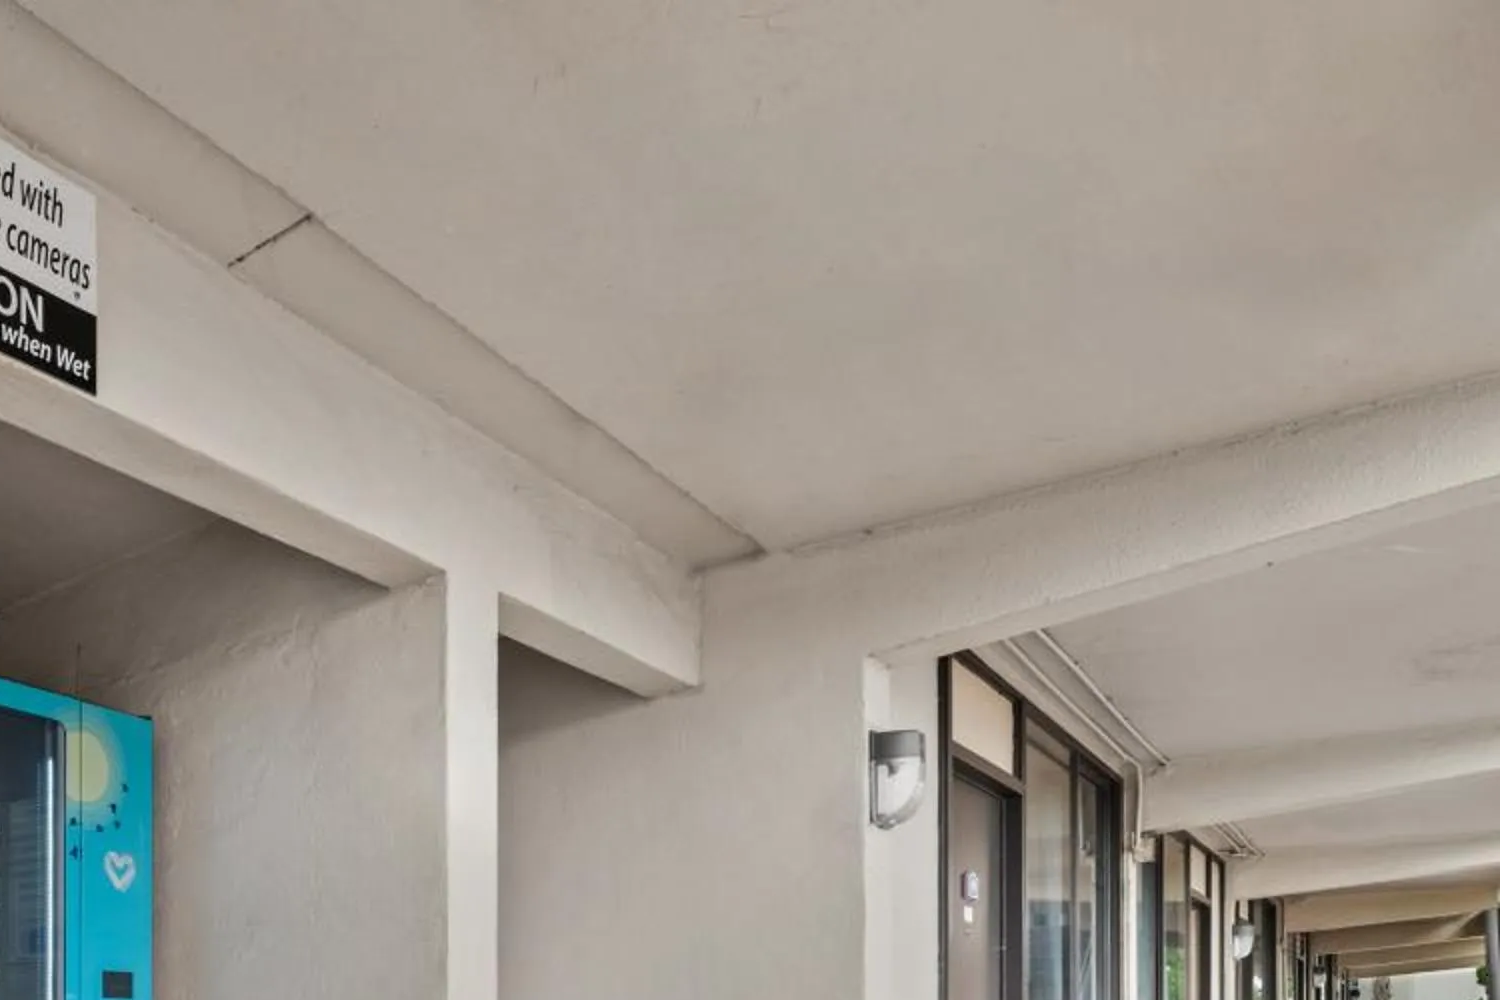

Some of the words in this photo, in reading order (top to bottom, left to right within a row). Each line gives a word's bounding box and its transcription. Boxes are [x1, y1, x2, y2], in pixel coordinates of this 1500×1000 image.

[20, 181, 63, 228] with
[6, 228, 91, 290] cameras
[1, 324, 52, 361] when
[56, 345, 92, 380] Wet
